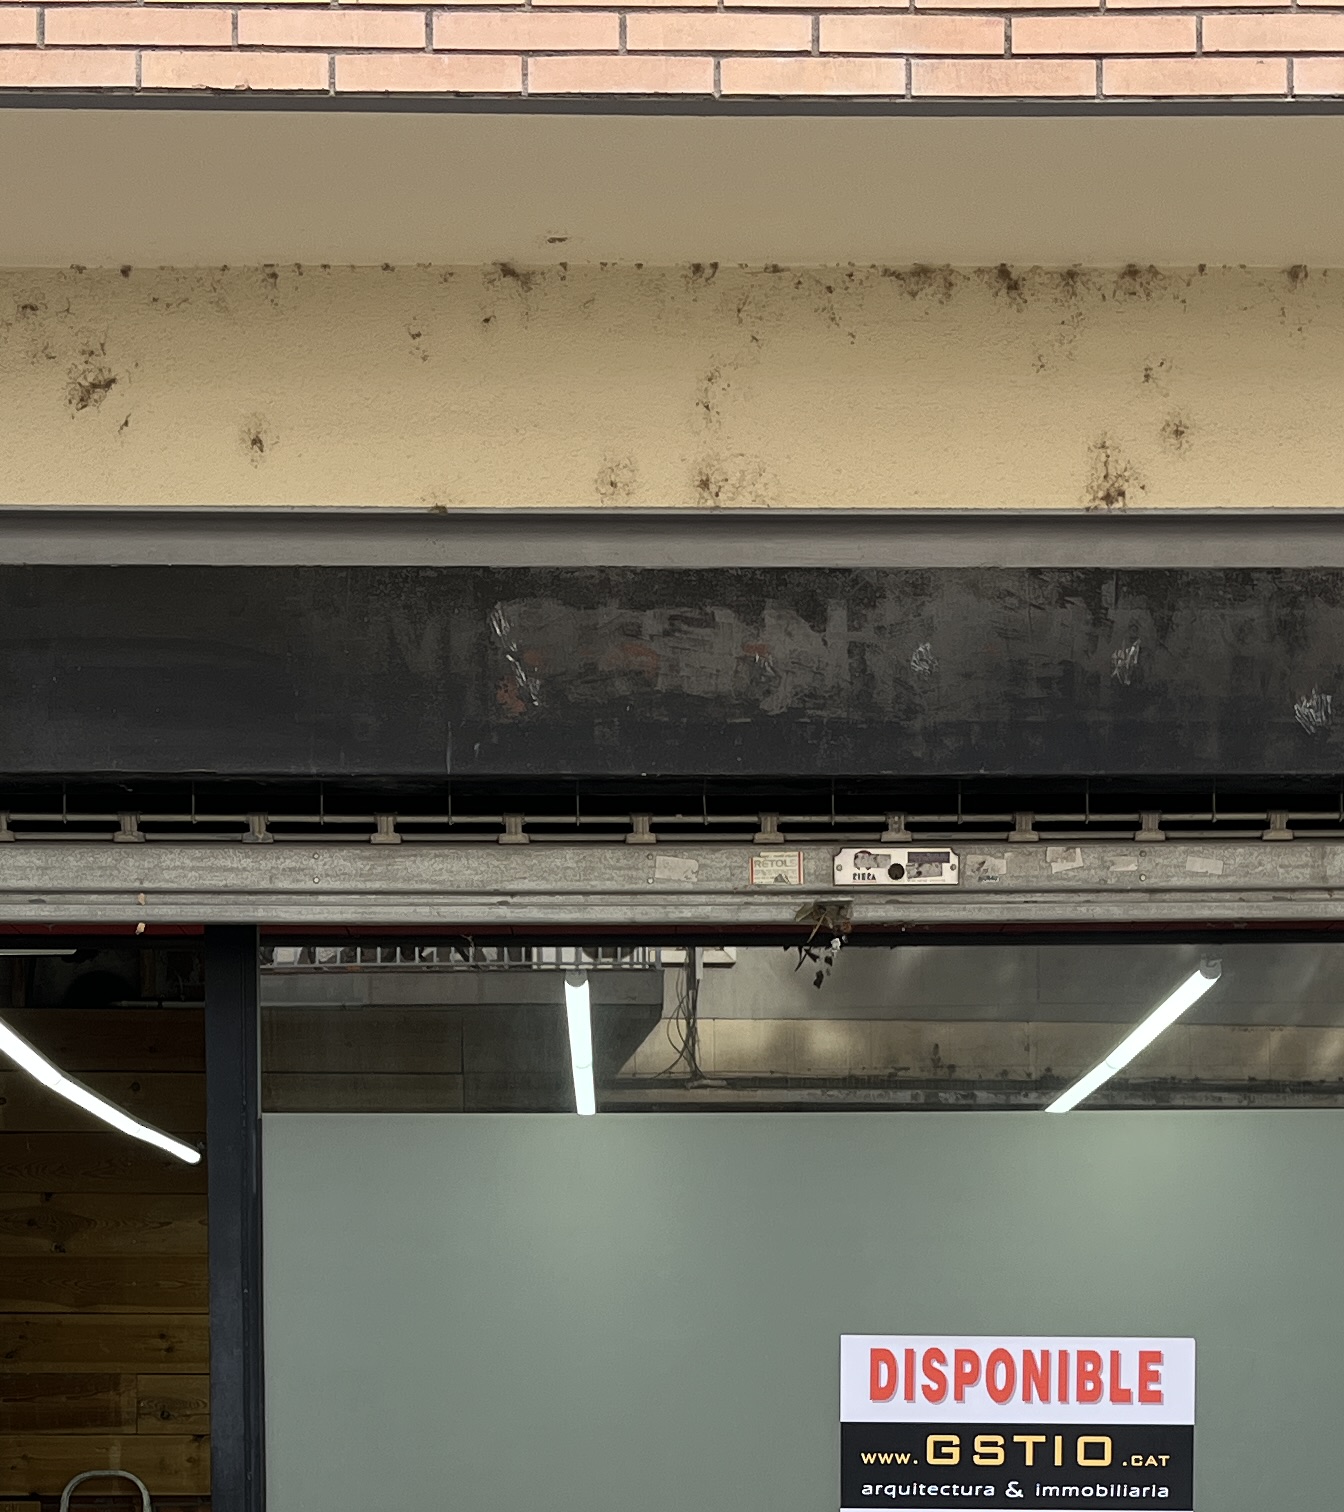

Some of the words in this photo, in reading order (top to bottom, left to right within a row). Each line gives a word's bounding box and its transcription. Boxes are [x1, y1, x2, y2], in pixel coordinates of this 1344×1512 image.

[869, 1347, 1163, 1405] DISPONIBLE
[861, 1482, 995, 1498] arquitectura
[1006, 1481, 1024, 1498] &
[1035, 1483, 1170, 1498] immobiliaria
